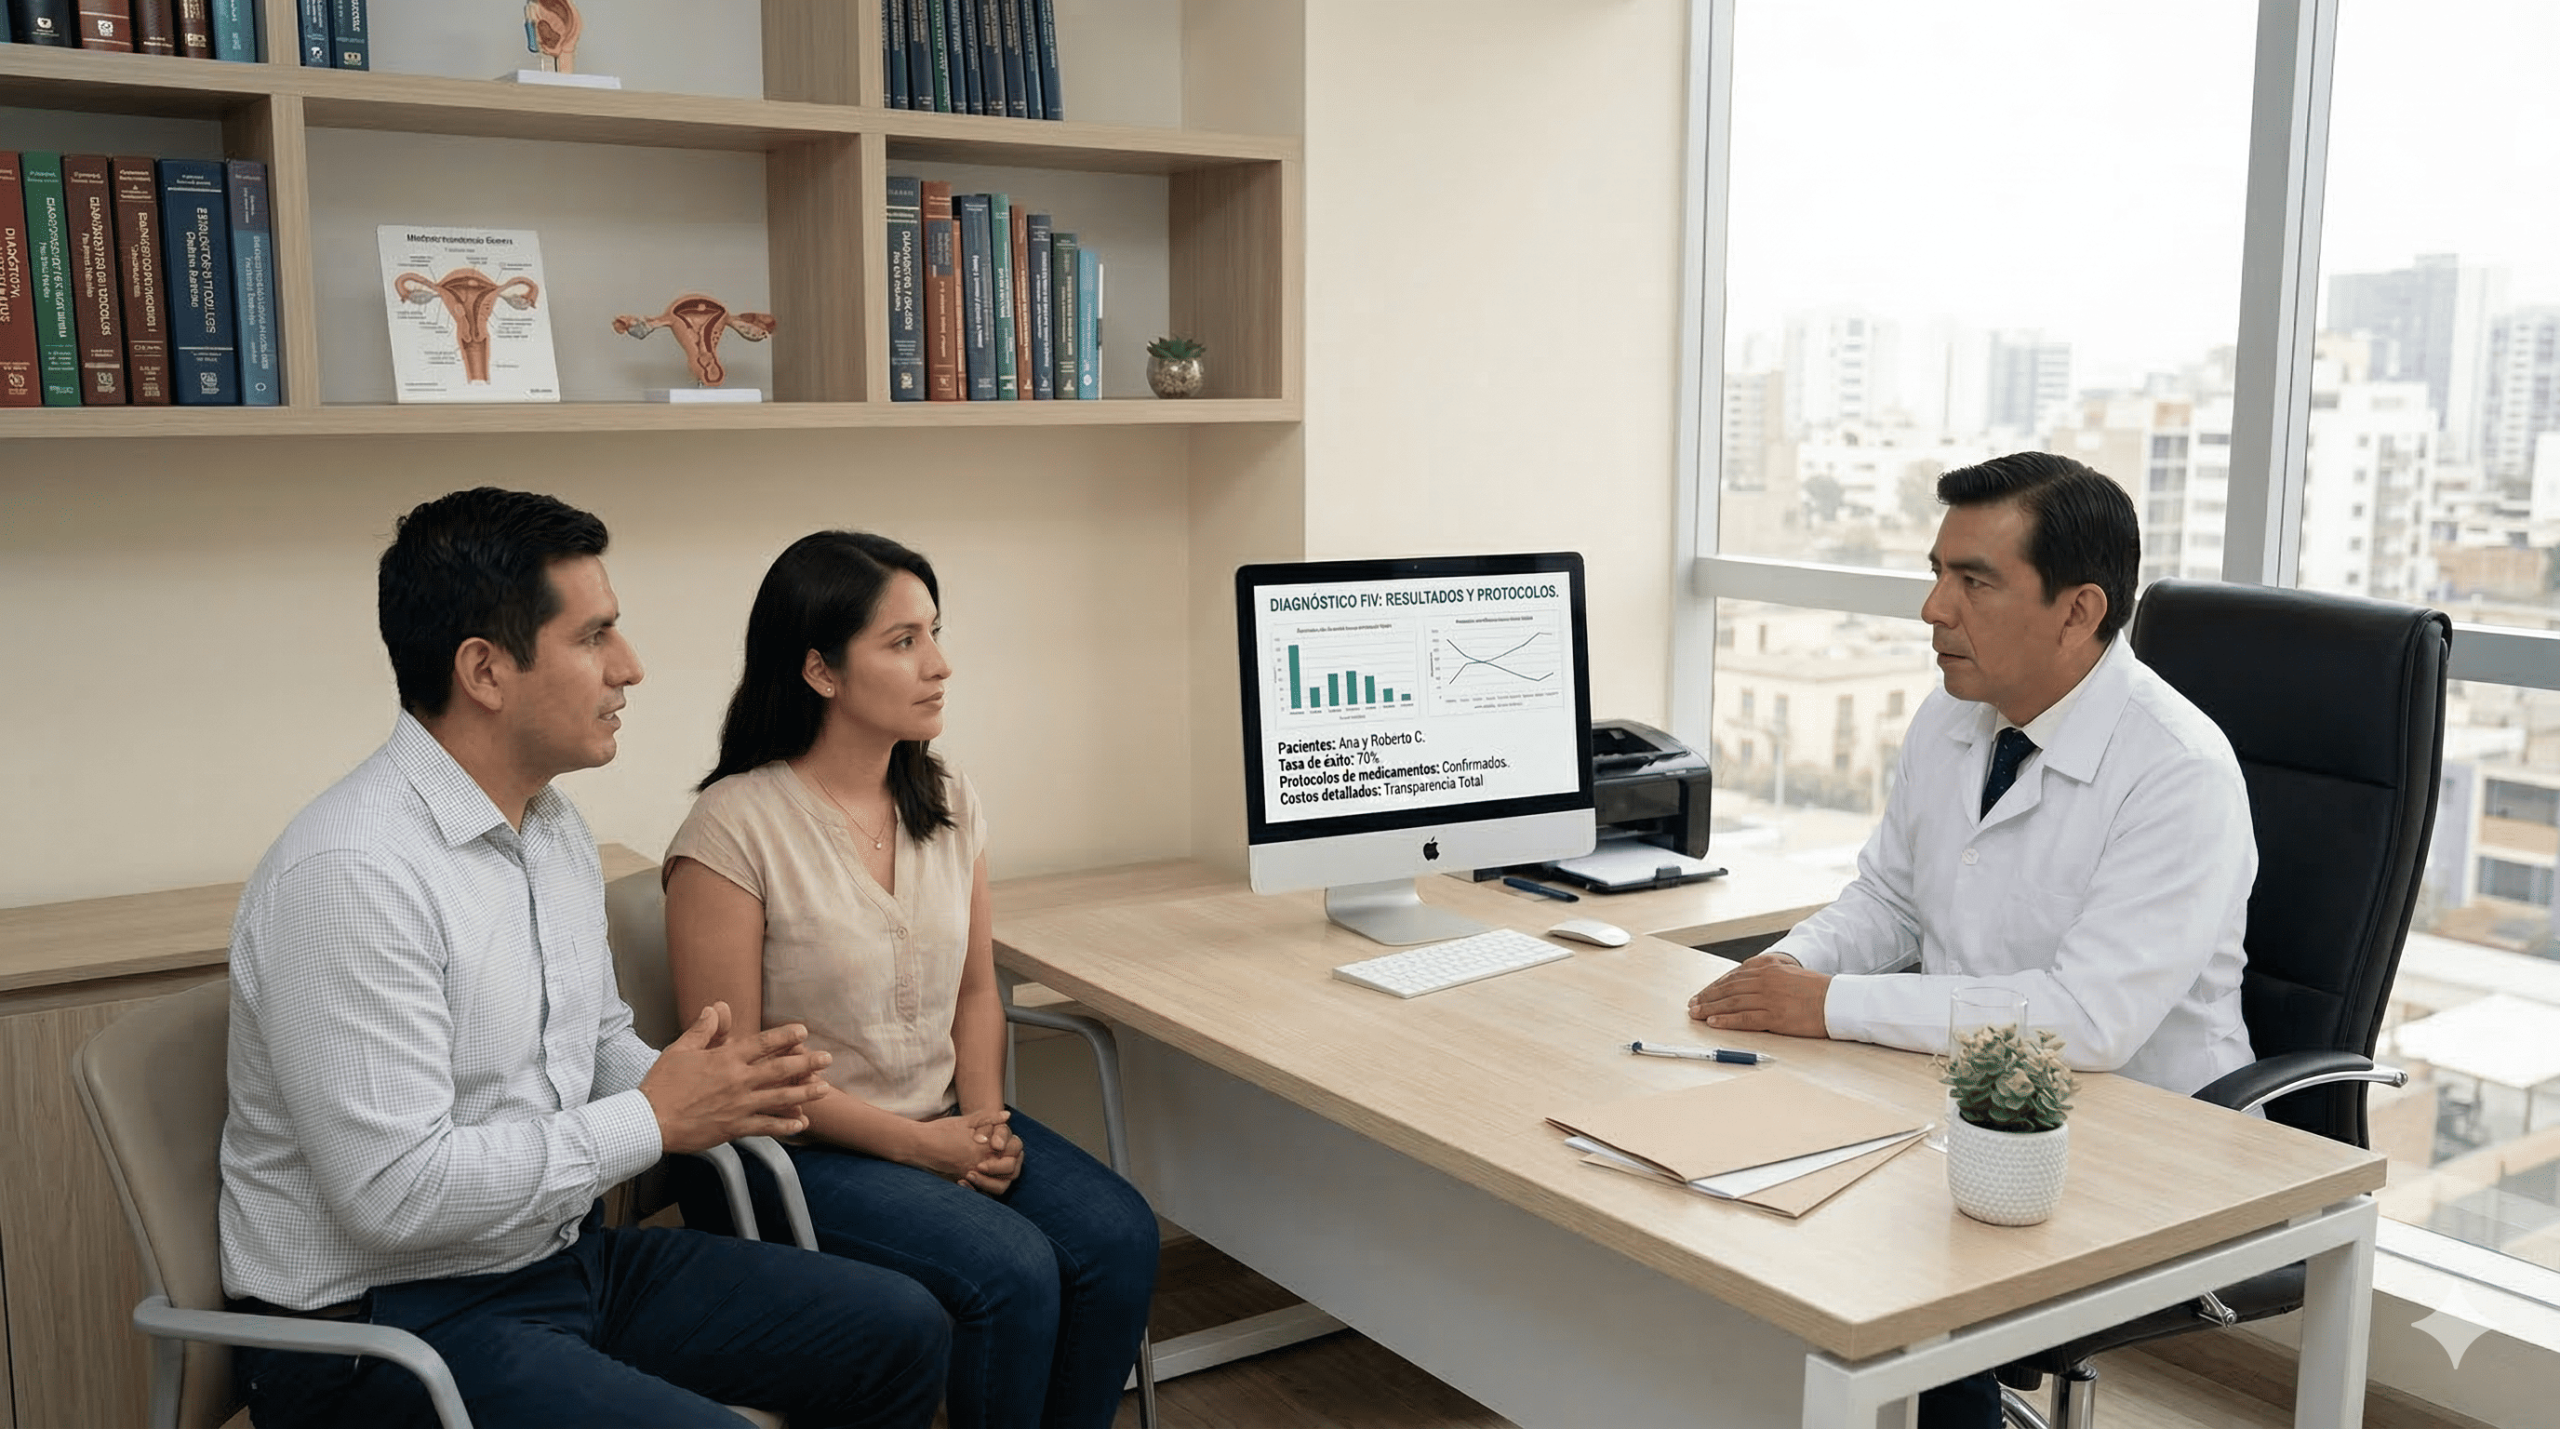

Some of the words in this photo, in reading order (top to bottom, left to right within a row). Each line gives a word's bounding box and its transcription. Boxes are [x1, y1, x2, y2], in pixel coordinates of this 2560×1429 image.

[1270, 592, 1357, 612] DIAGNÓSTICO
[1360, 593, 1382, 607] FIV:
[1385, 589, 1464, 606] RESULTADOS
[1466, 588, 1475, 602] Y
[1477, 585, 1559, 601] PROTOCOLOS.
[1278, 739, 1336, 755] Pacientes:
[1339, 737, 1360, 749] Ana
[1361, 737, 1369, 751] y
[1370, 732, 1412, 747] Roberto
[1414, 730, 1426, 743] C.
[1278, 758, 1305, 771] Tasa
[1307, 755, 1322, 769] de
[1356, 751, 1380, 765] 70%
[1279, 771, 1340, 788] Protocolos
[1342, 768, 1356, 782] de
[1358, 763, 1440, 781] medicamentos:
[1442, 756, 1511, 773] Confirmados.
[1280, 791, 1319, 805] Costos
[1321, 784, 1382, 801] detallados:
[1383, 776, 1457, 797] Transparencia
[1458, 774, 1484, 788] Total
